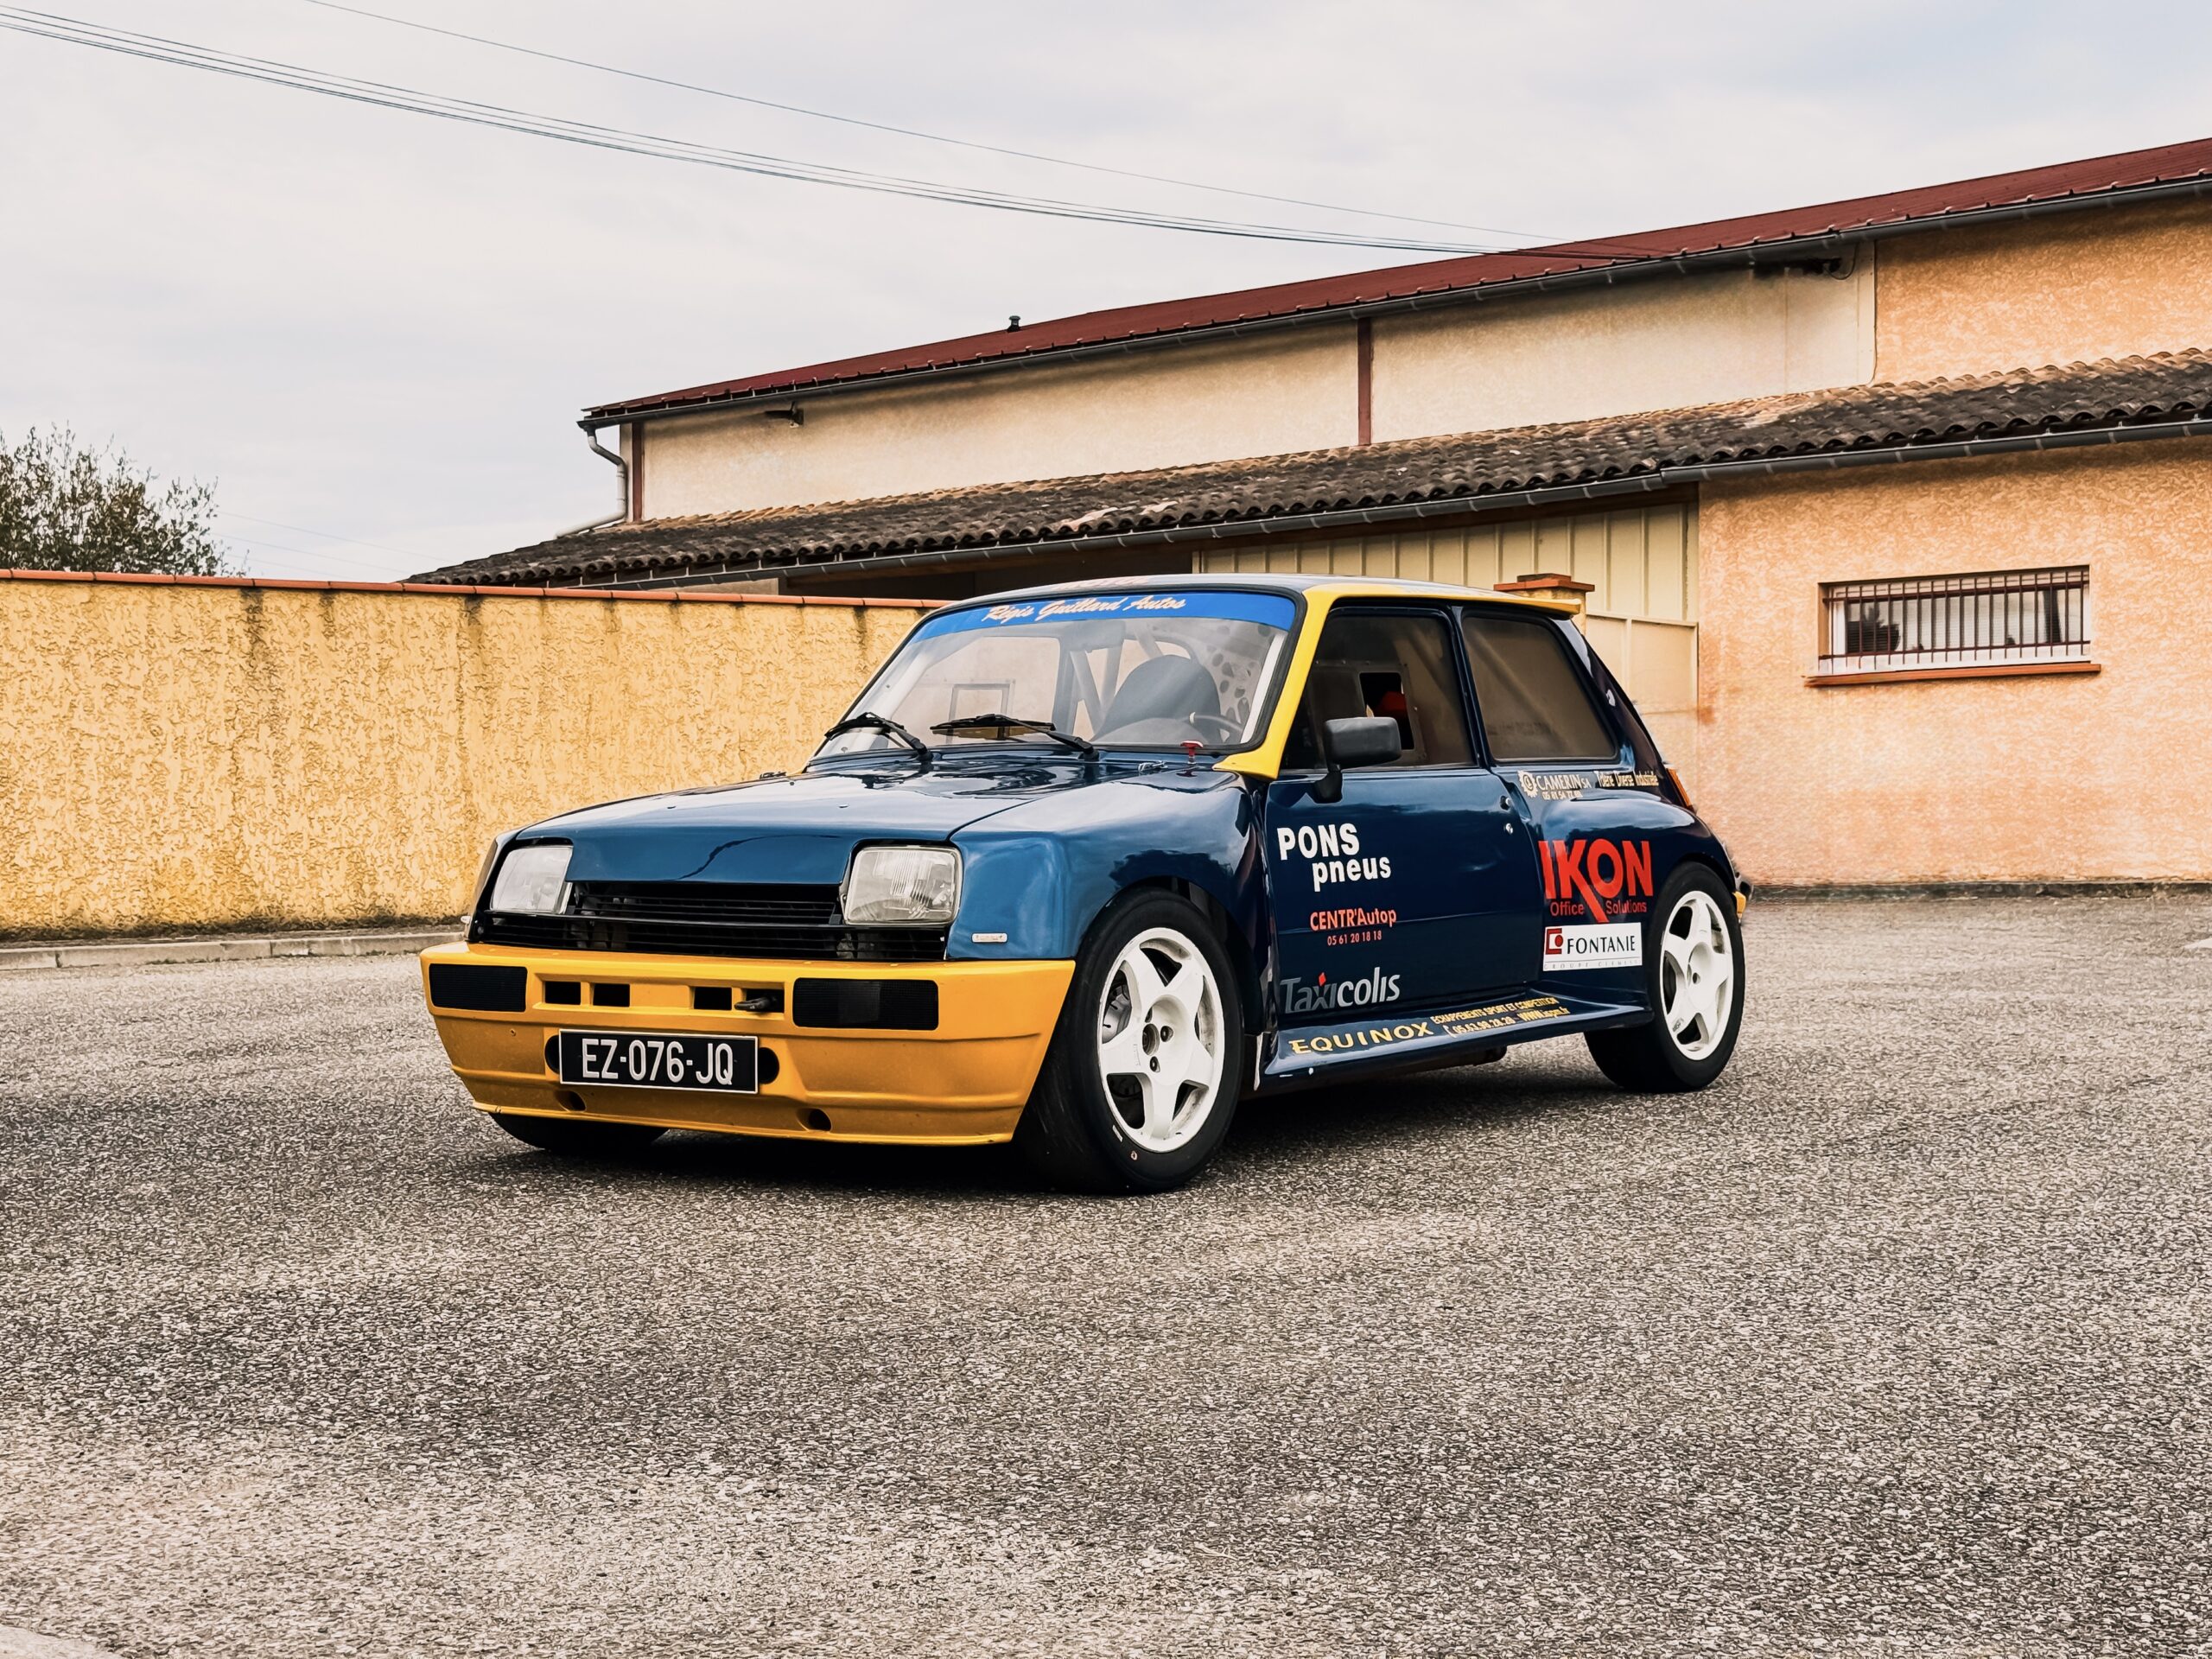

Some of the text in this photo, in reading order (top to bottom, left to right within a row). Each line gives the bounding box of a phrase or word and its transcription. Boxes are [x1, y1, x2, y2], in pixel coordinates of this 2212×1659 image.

[1122, 595, 1186, 612] Autos
[1536, 774, 1582, 790] CAMERIN
[1581, 778, 1592, 789] SA
[1277, 823, 1360, 861] PONS
[1312, 857, 1391, 893] pneus
[1539, 839, 1654, 923] IKON
[1310, 907, 1397, 931] CENTR'Autop
[1550, 899, 1647, 916] Office Solutions
[1327, 931, 1382, 945] 05 61 20 18 18
[1280, 967, 1400, 1014] Taxicolis
[1483, 1005, 1509, 1015] SPORT
[1505, 1002, 1517, 1012] ET
[1514, 997, 1560, 1009] COMPETITION
[1288, 1021, 1434, 1054] EQUINOX
[582, 1039, 734, 1085] EZ-076-JQ
